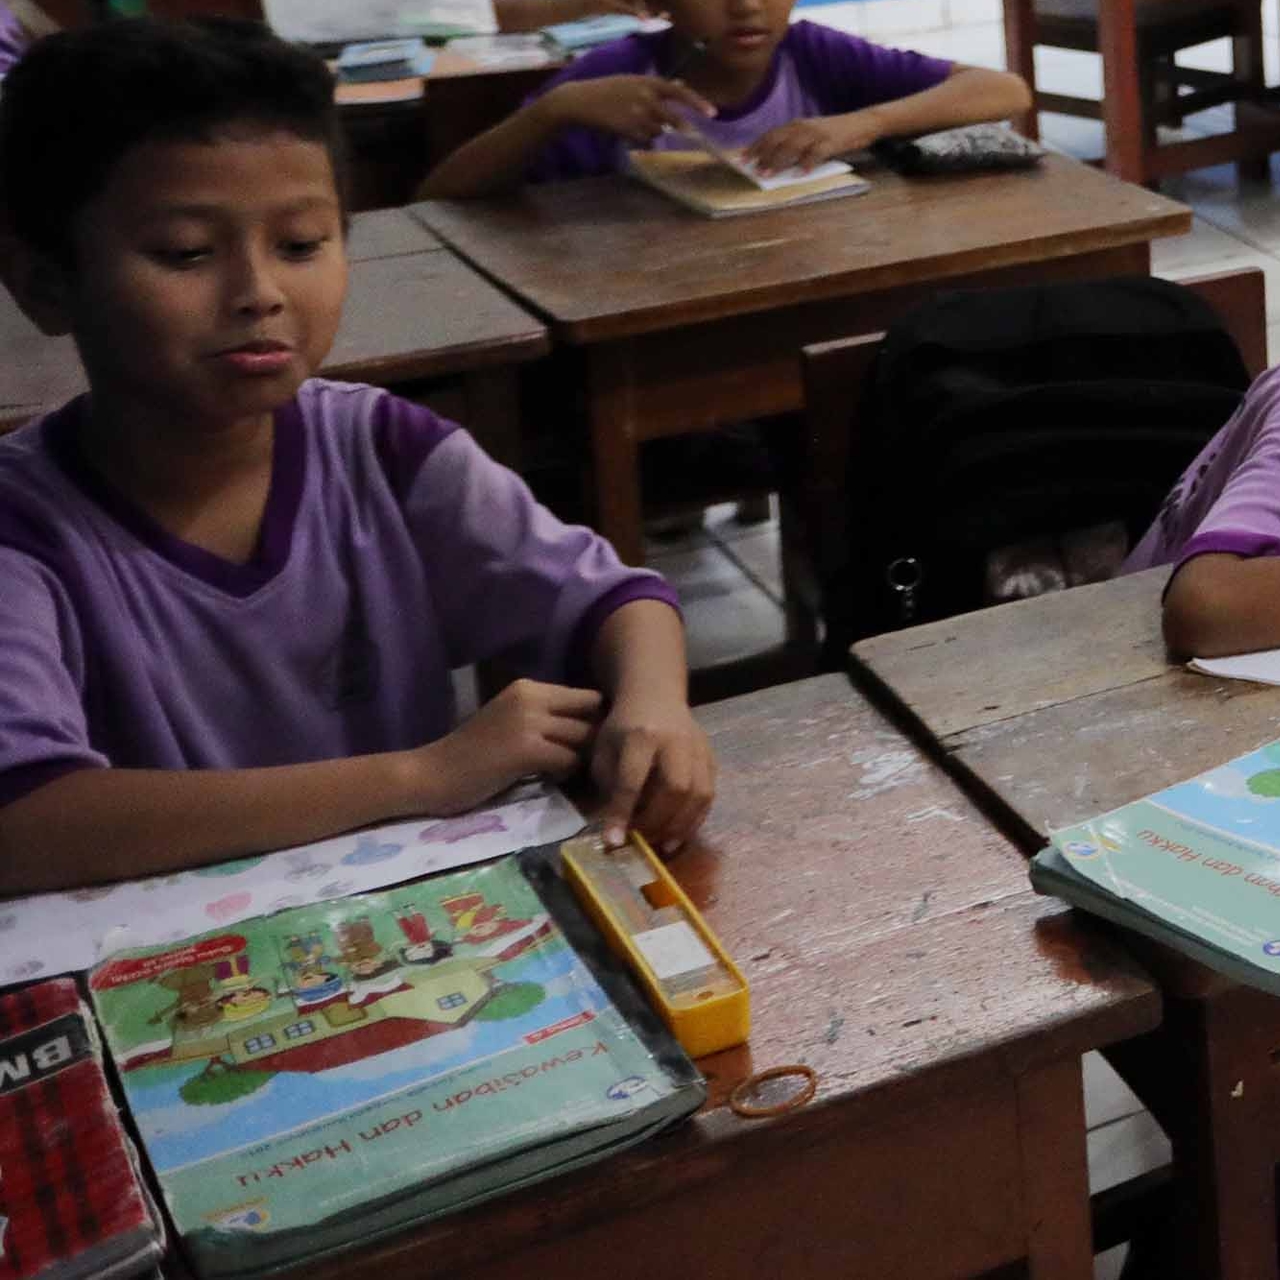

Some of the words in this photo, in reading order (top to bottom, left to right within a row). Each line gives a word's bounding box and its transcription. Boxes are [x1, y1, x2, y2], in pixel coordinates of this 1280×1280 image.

[1137, 828, 1201, 862] Hakku
[1202, 856, 1244, 877] dan
[358, 1107, 424, 1142] dan
[235, 1138, 353, 1188] Hakku
